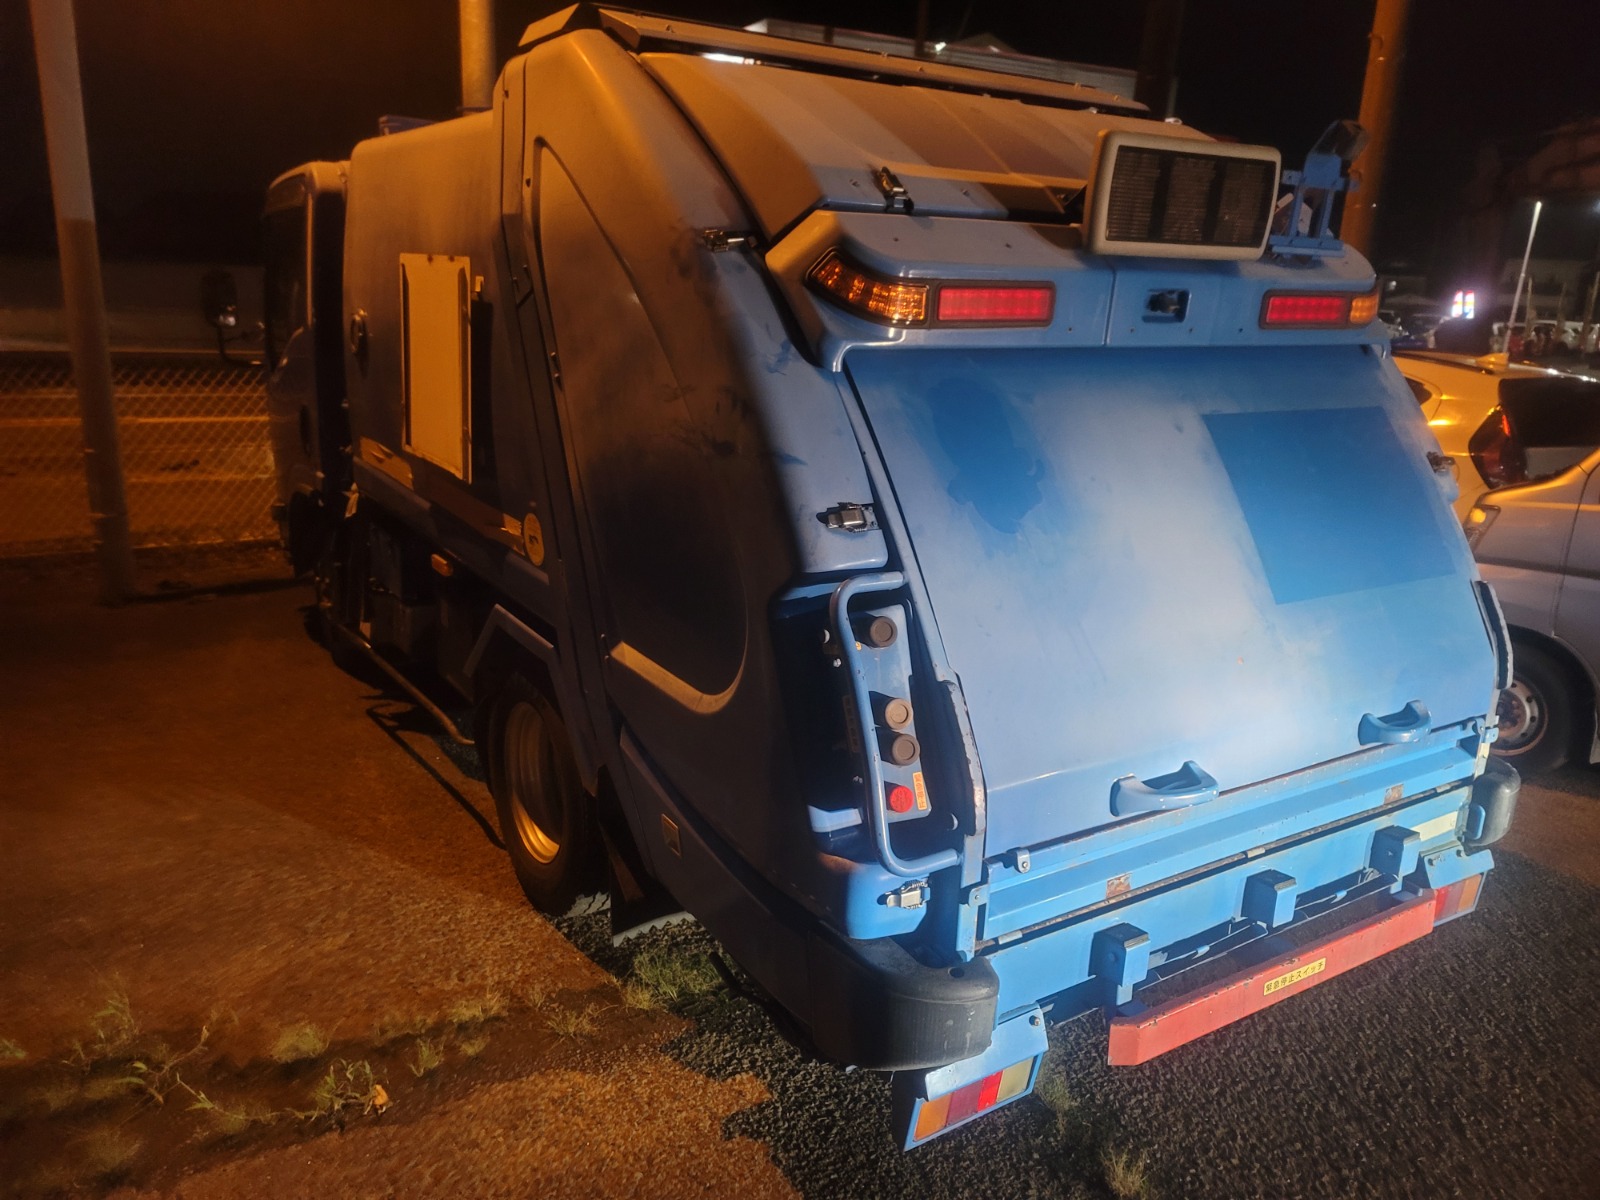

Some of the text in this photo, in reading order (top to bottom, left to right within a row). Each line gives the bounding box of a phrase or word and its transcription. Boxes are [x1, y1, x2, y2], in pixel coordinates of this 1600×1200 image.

[1265, 960, 1324, 993] 緊急停止スイッチ
